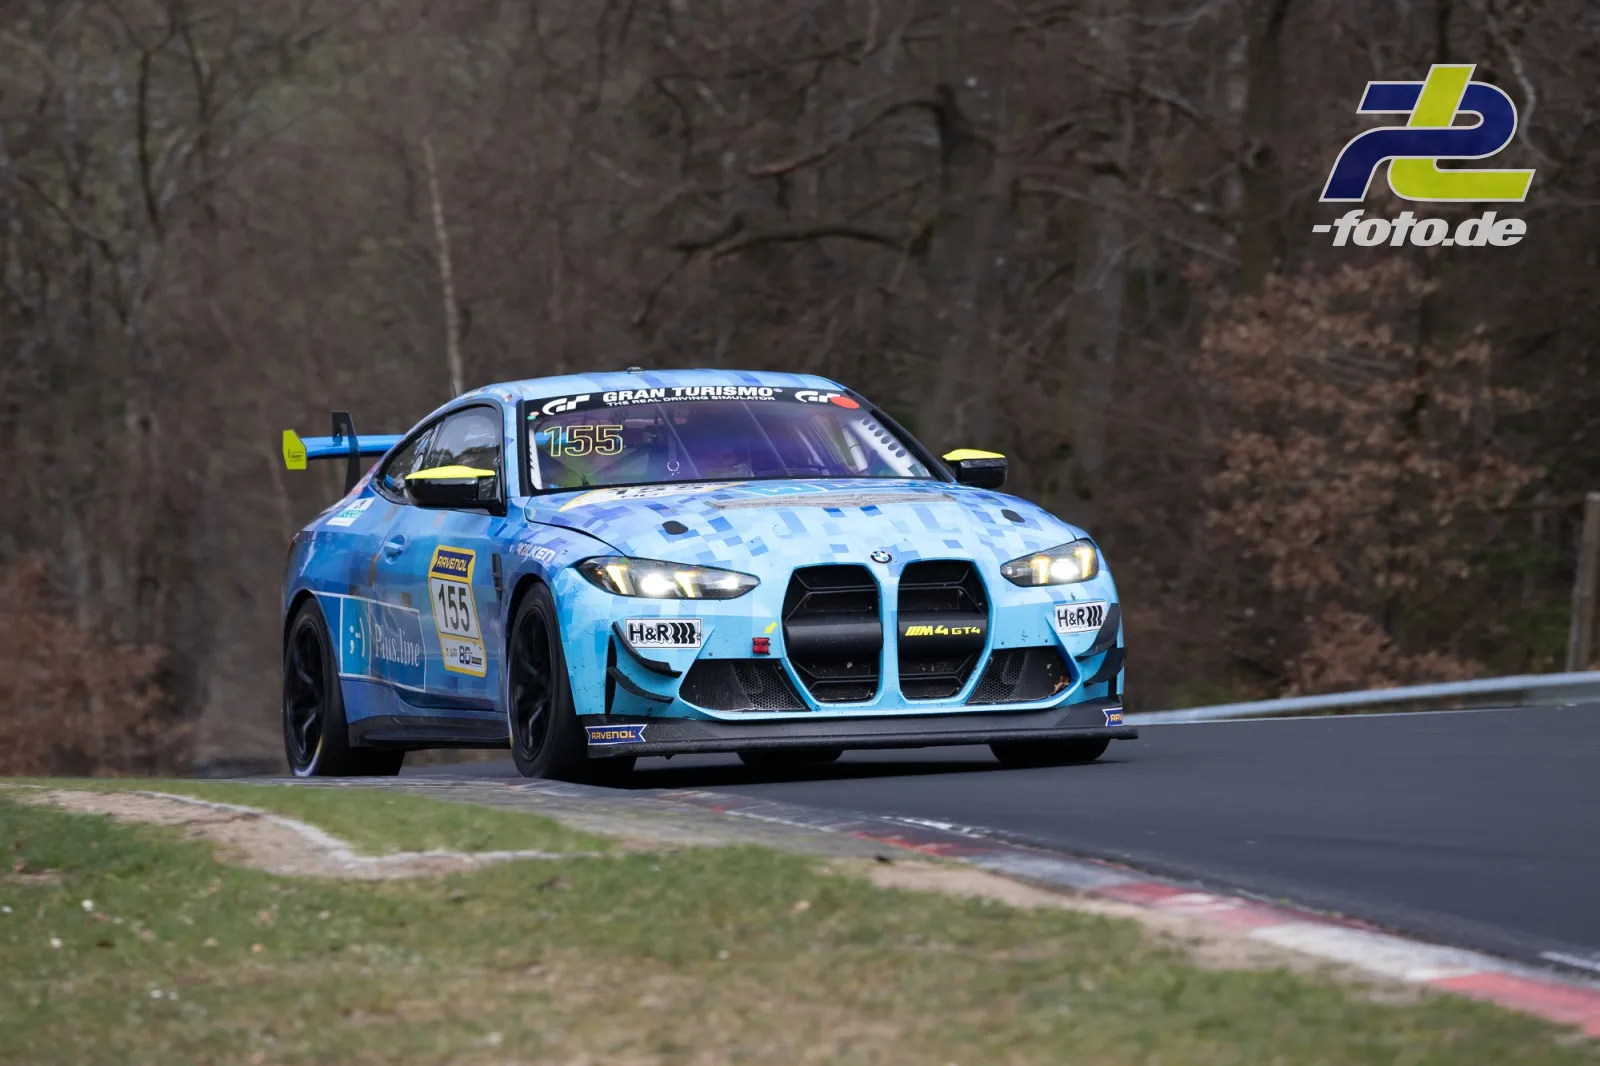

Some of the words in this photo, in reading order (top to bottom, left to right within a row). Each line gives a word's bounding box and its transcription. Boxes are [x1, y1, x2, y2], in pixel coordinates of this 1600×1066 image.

[602, 388, 665, 403] GRAN
[543, 424, 623, 457] 155
[436, 555, 467, 572] RAVENOL
[438, 583, 470, 632] 155
[1057, 607, 1085, 628] H&R
[629, 623, 672, 643] H&R
[951, 626, 981, 635] GT4
[591, 730, 636, 740] RAVENOL
